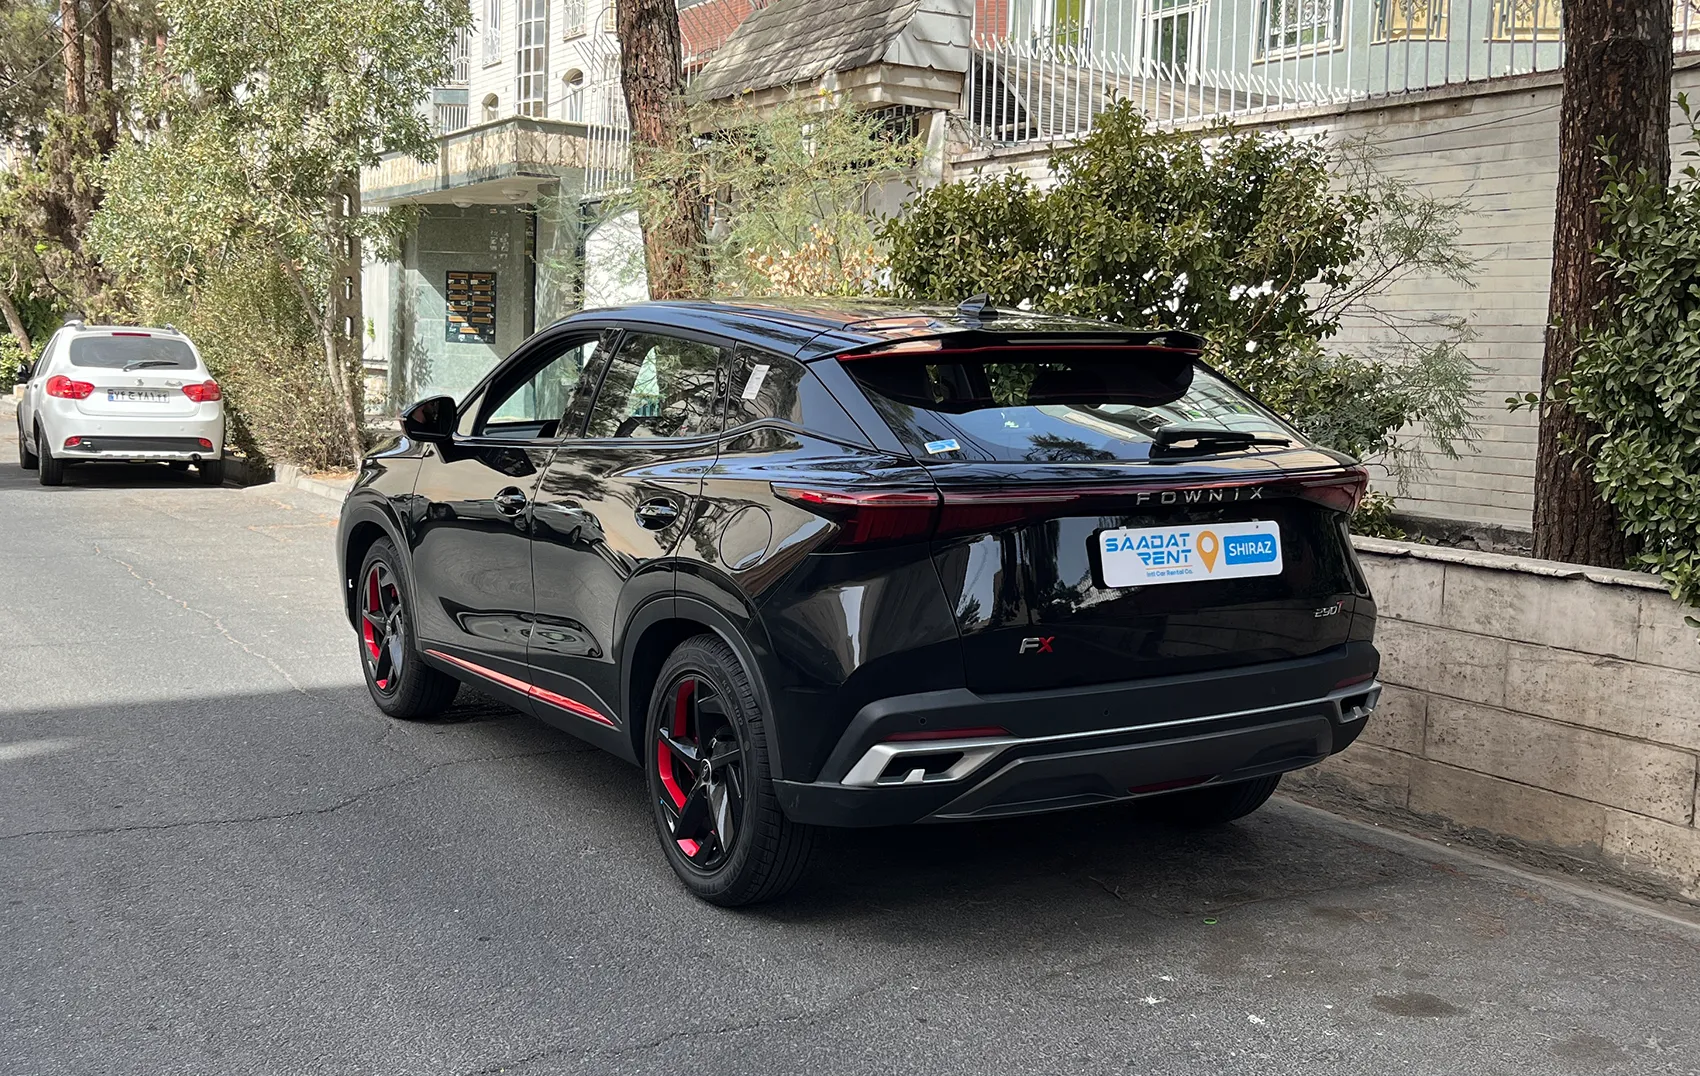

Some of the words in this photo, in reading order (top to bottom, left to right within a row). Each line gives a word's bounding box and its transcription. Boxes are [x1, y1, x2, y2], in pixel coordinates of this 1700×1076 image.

[1136, 487, 1264, 505] FOWNIX
[1105, 533, 1190, 552] SAADAT
[1228, 541, 1272, 556] SHIRAZ
[1136, 549, 1191, 566] RENT
[1166, 568, 1184, 577] Rental
[1019, 636, 1055, 654] FX
